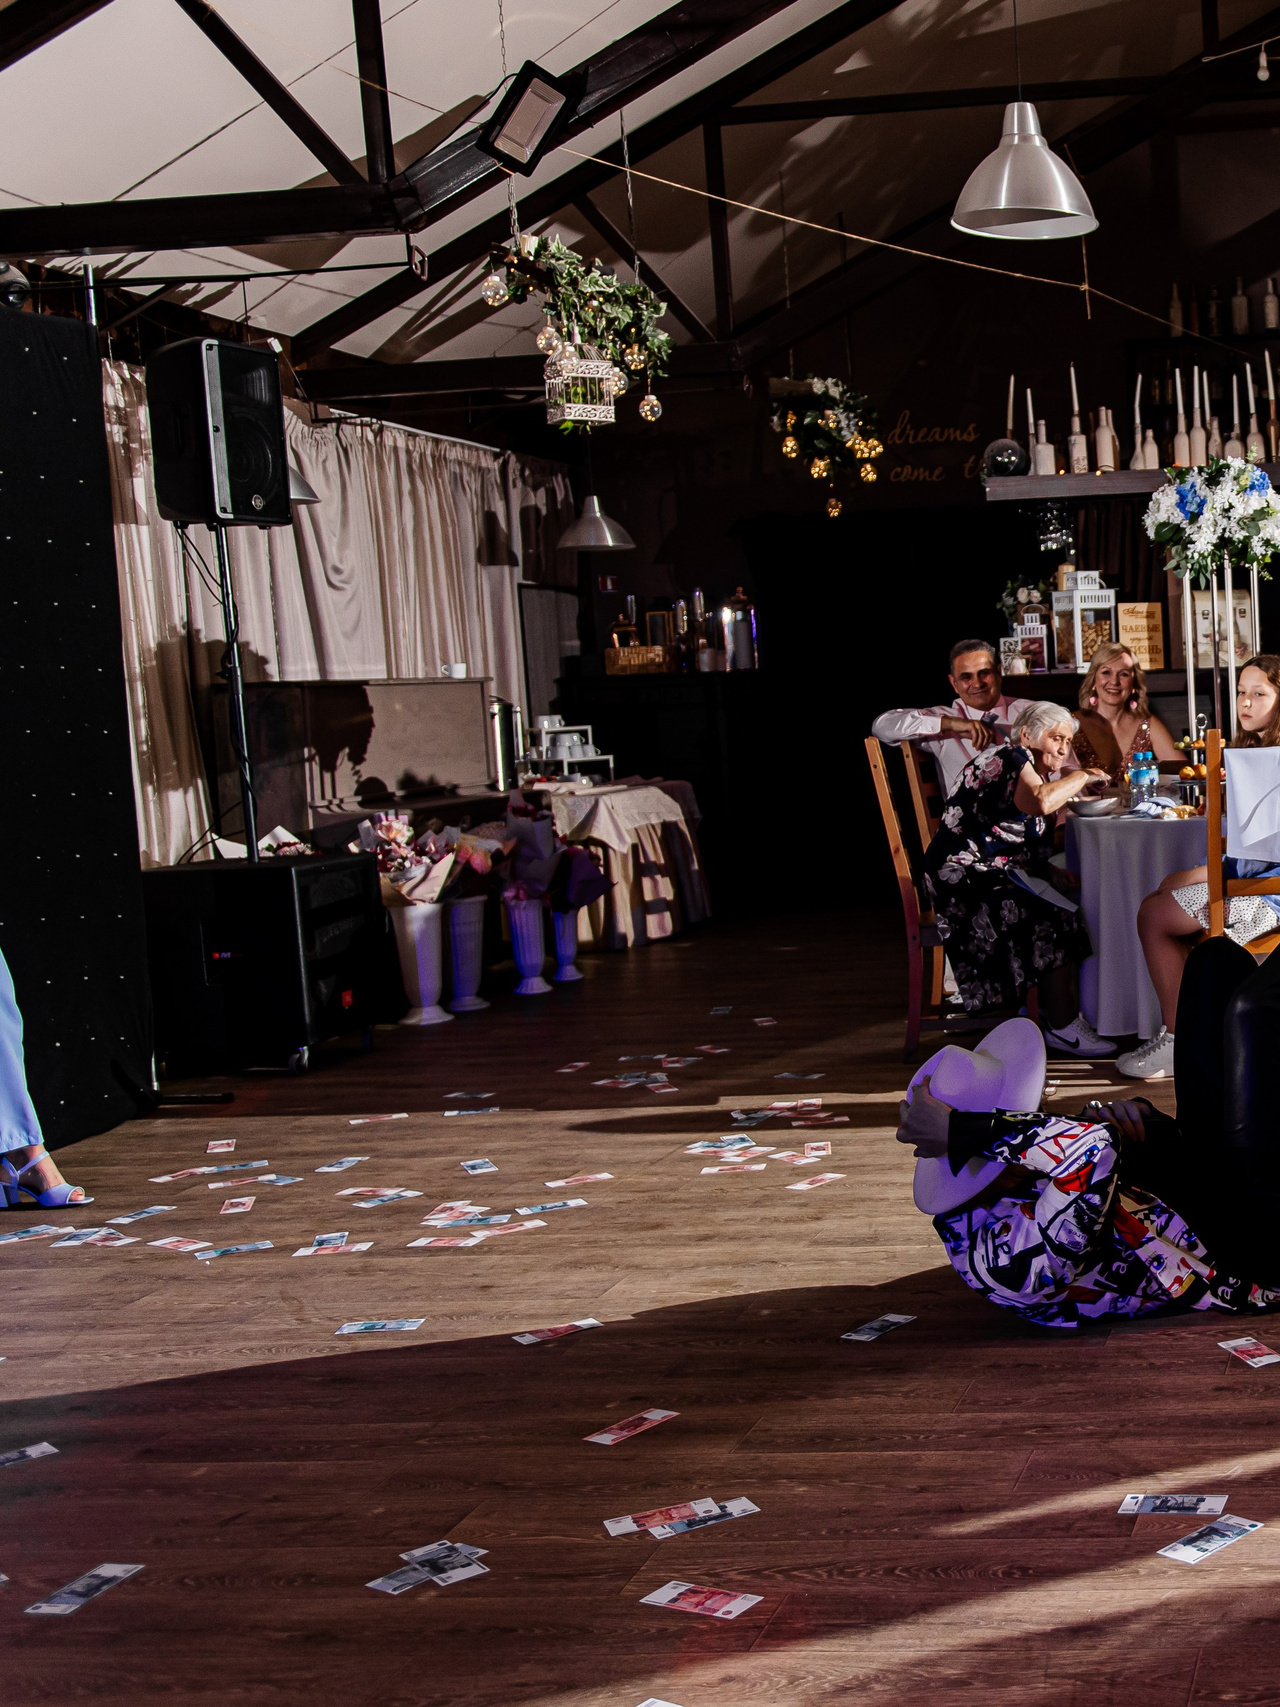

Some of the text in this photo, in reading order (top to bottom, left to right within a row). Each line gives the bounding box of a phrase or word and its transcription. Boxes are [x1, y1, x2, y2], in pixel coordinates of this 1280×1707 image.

[887, 410, 979, 444] dreams
[890, 464, 945, 482] come
[1121, 623, 1162, 633] ЧАЕВЫЕ
